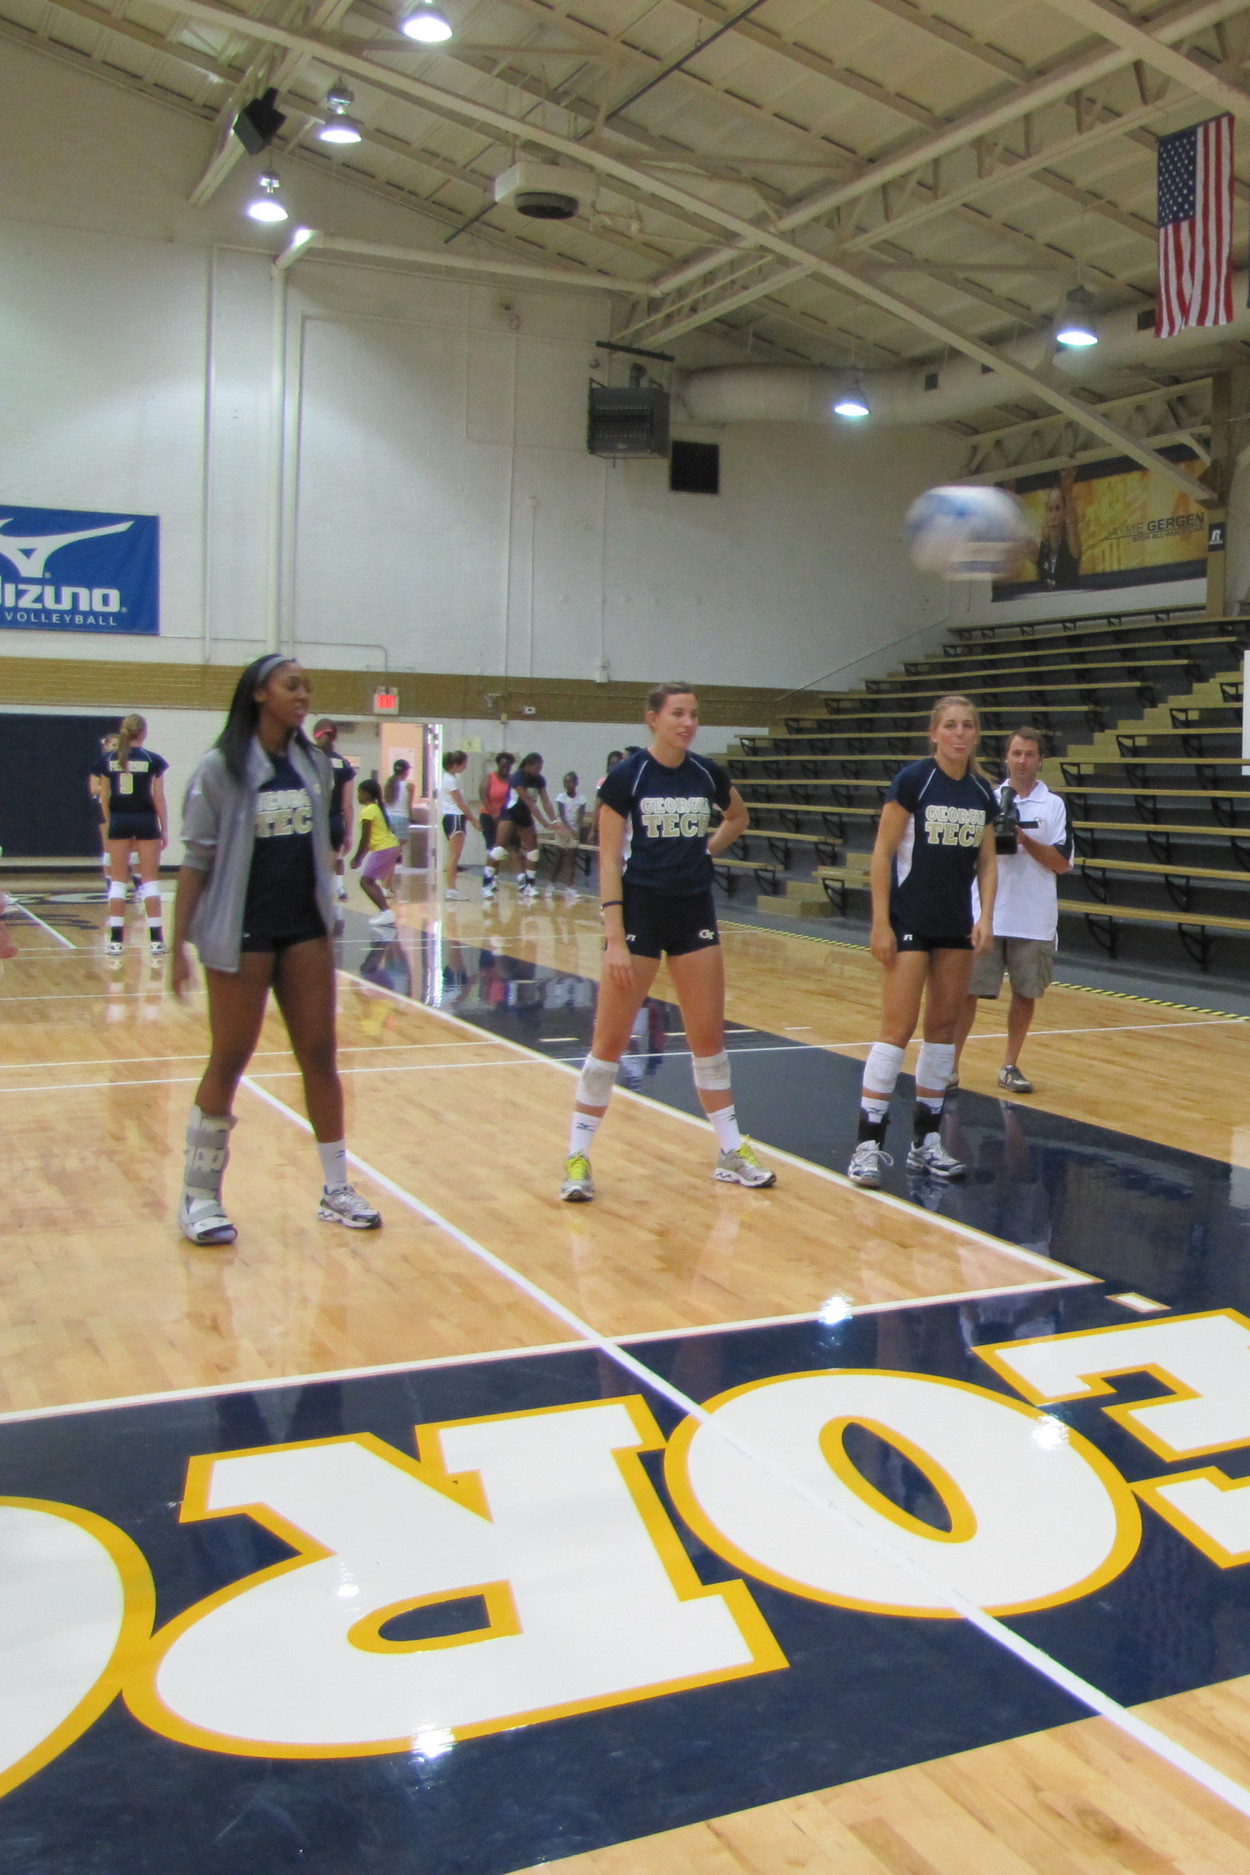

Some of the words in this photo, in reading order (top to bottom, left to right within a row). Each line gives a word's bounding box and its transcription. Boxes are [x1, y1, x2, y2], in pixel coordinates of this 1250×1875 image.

[1147, 511, 1205, 532] GERGEN
[0, 574, 121, 613] IZUNO
[5, 611, 117, 626] VOLLEYBALL
[256, 806, 313, 838] TEC
